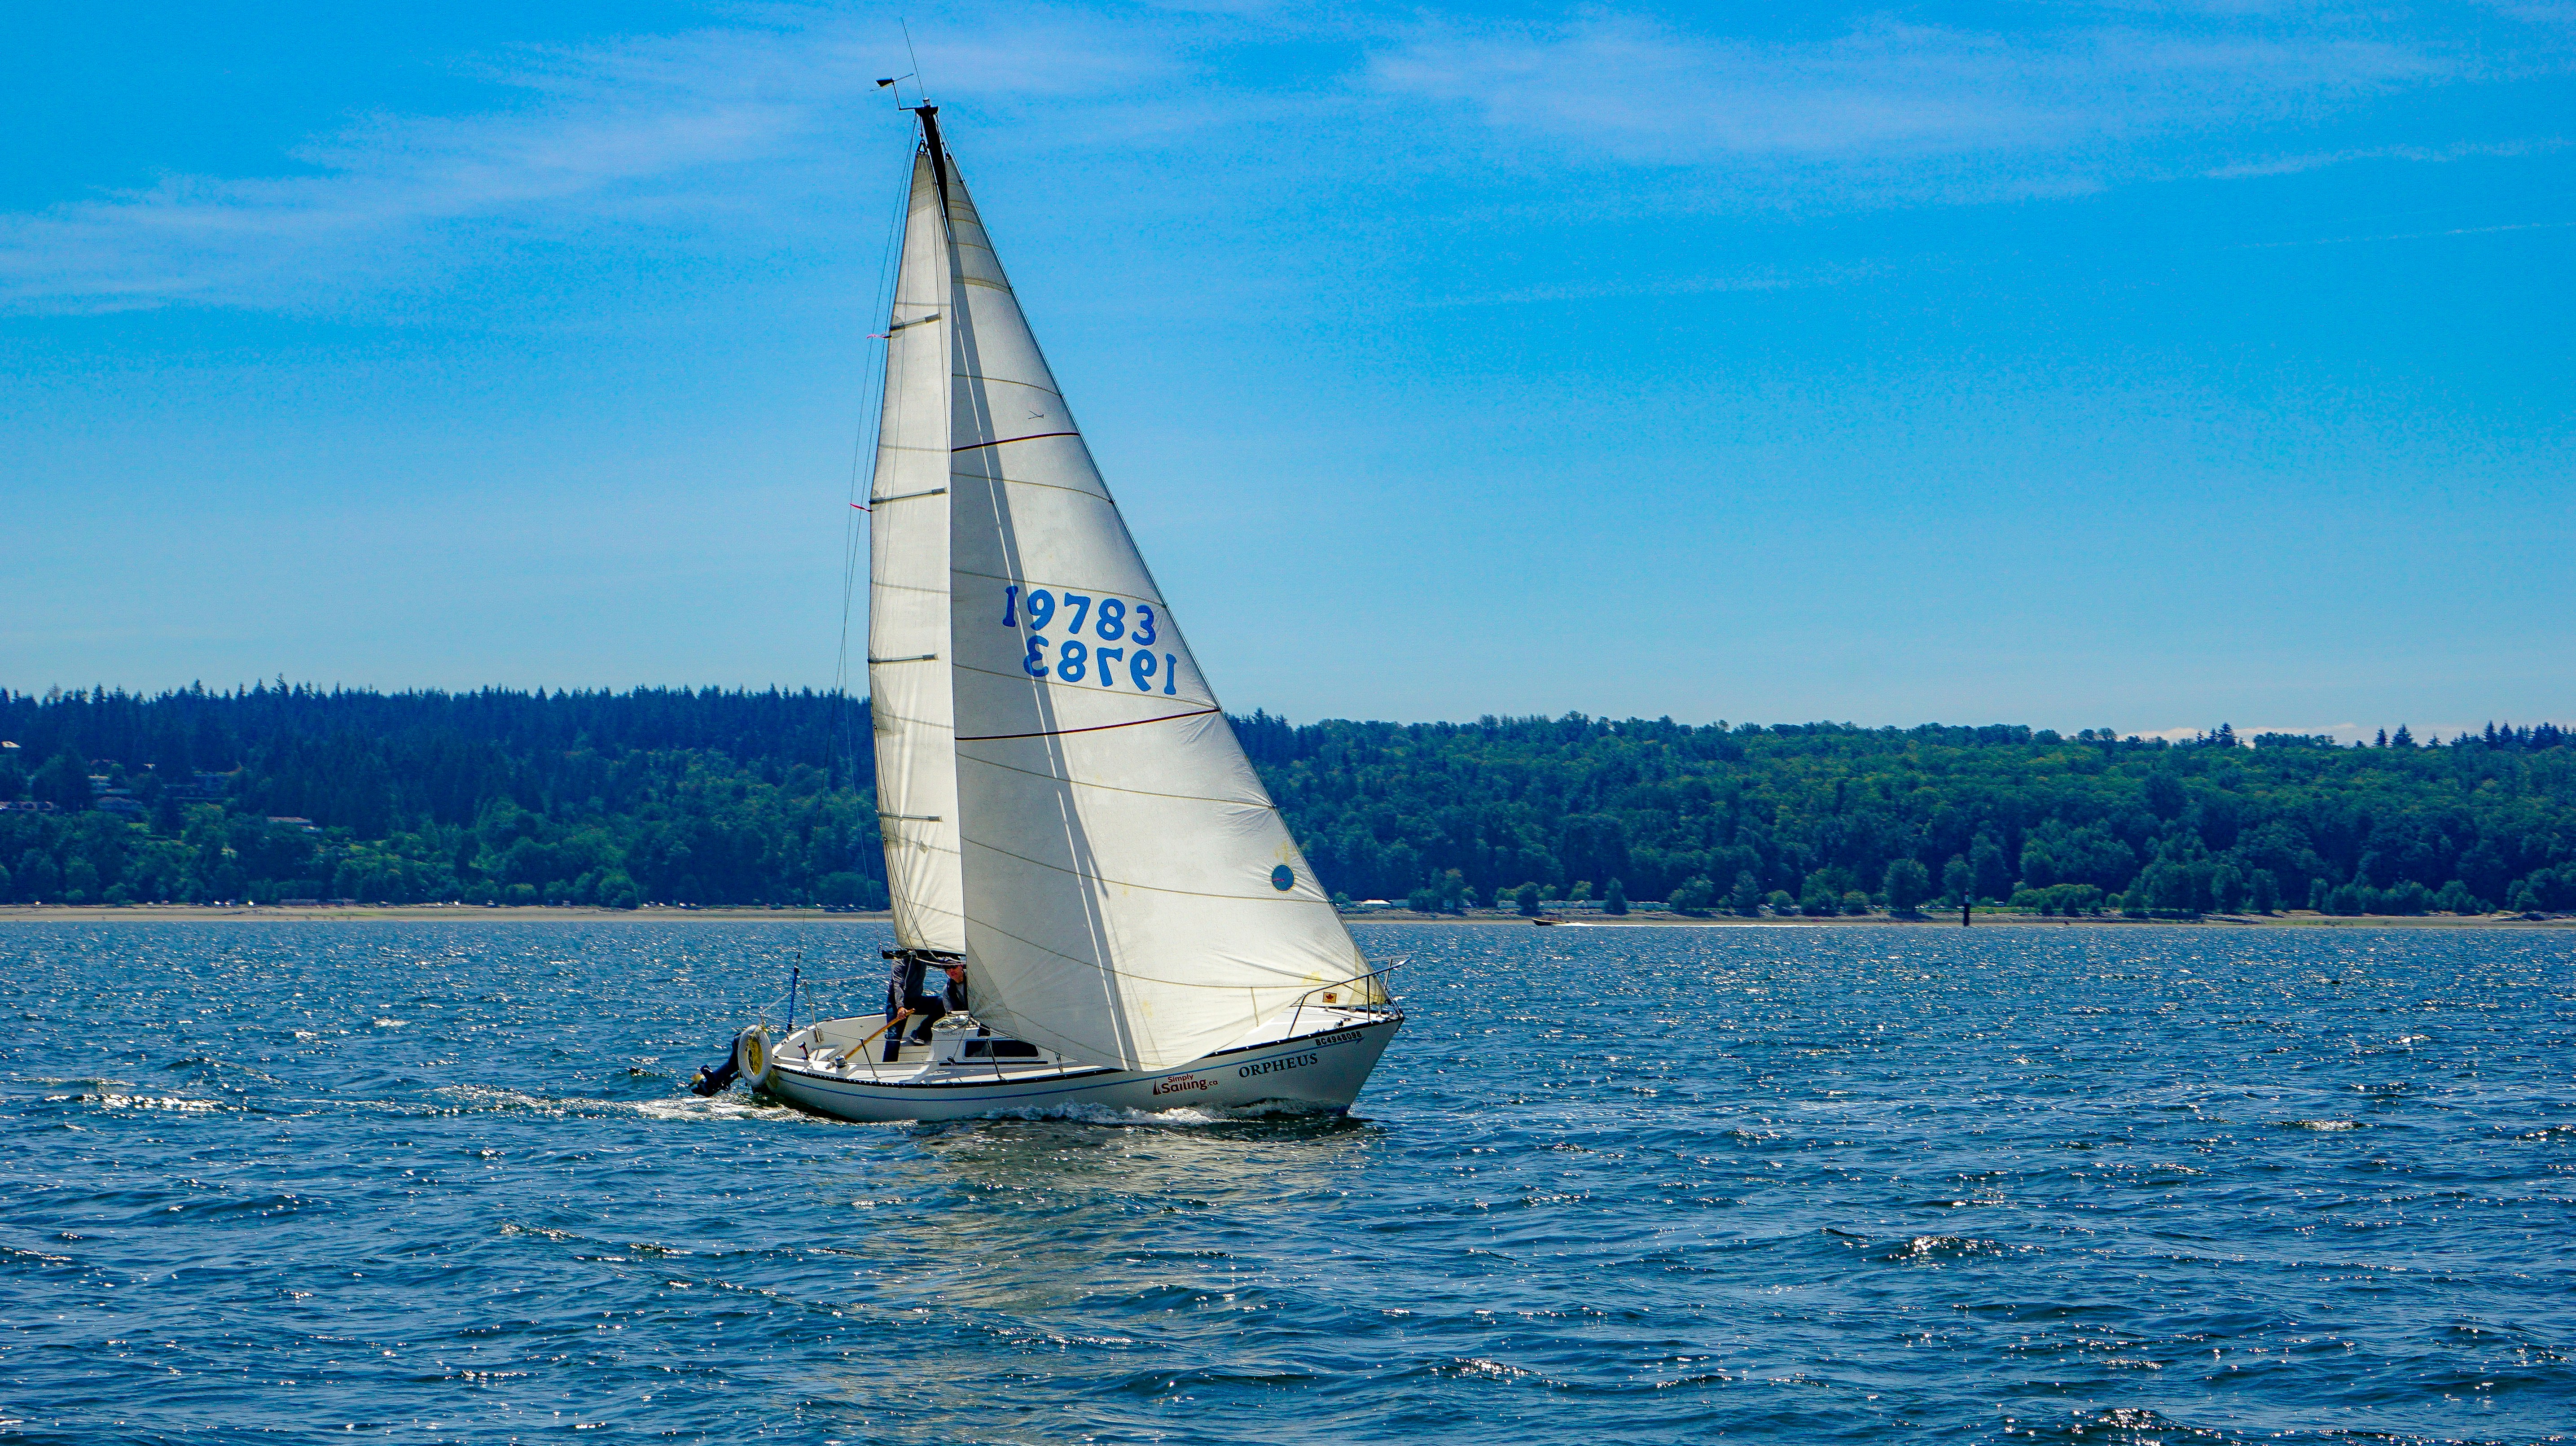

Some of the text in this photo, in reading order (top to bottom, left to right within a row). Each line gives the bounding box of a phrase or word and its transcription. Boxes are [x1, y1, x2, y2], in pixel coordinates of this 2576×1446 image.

[1002, 585, 1157, 646] 19783
[1238, 1052, 1318, 1078] ORPHEUS
[1161, 1079, 1219, 1094] Sailing.ca
[1167, 1073, 1194, 1083] Simply
